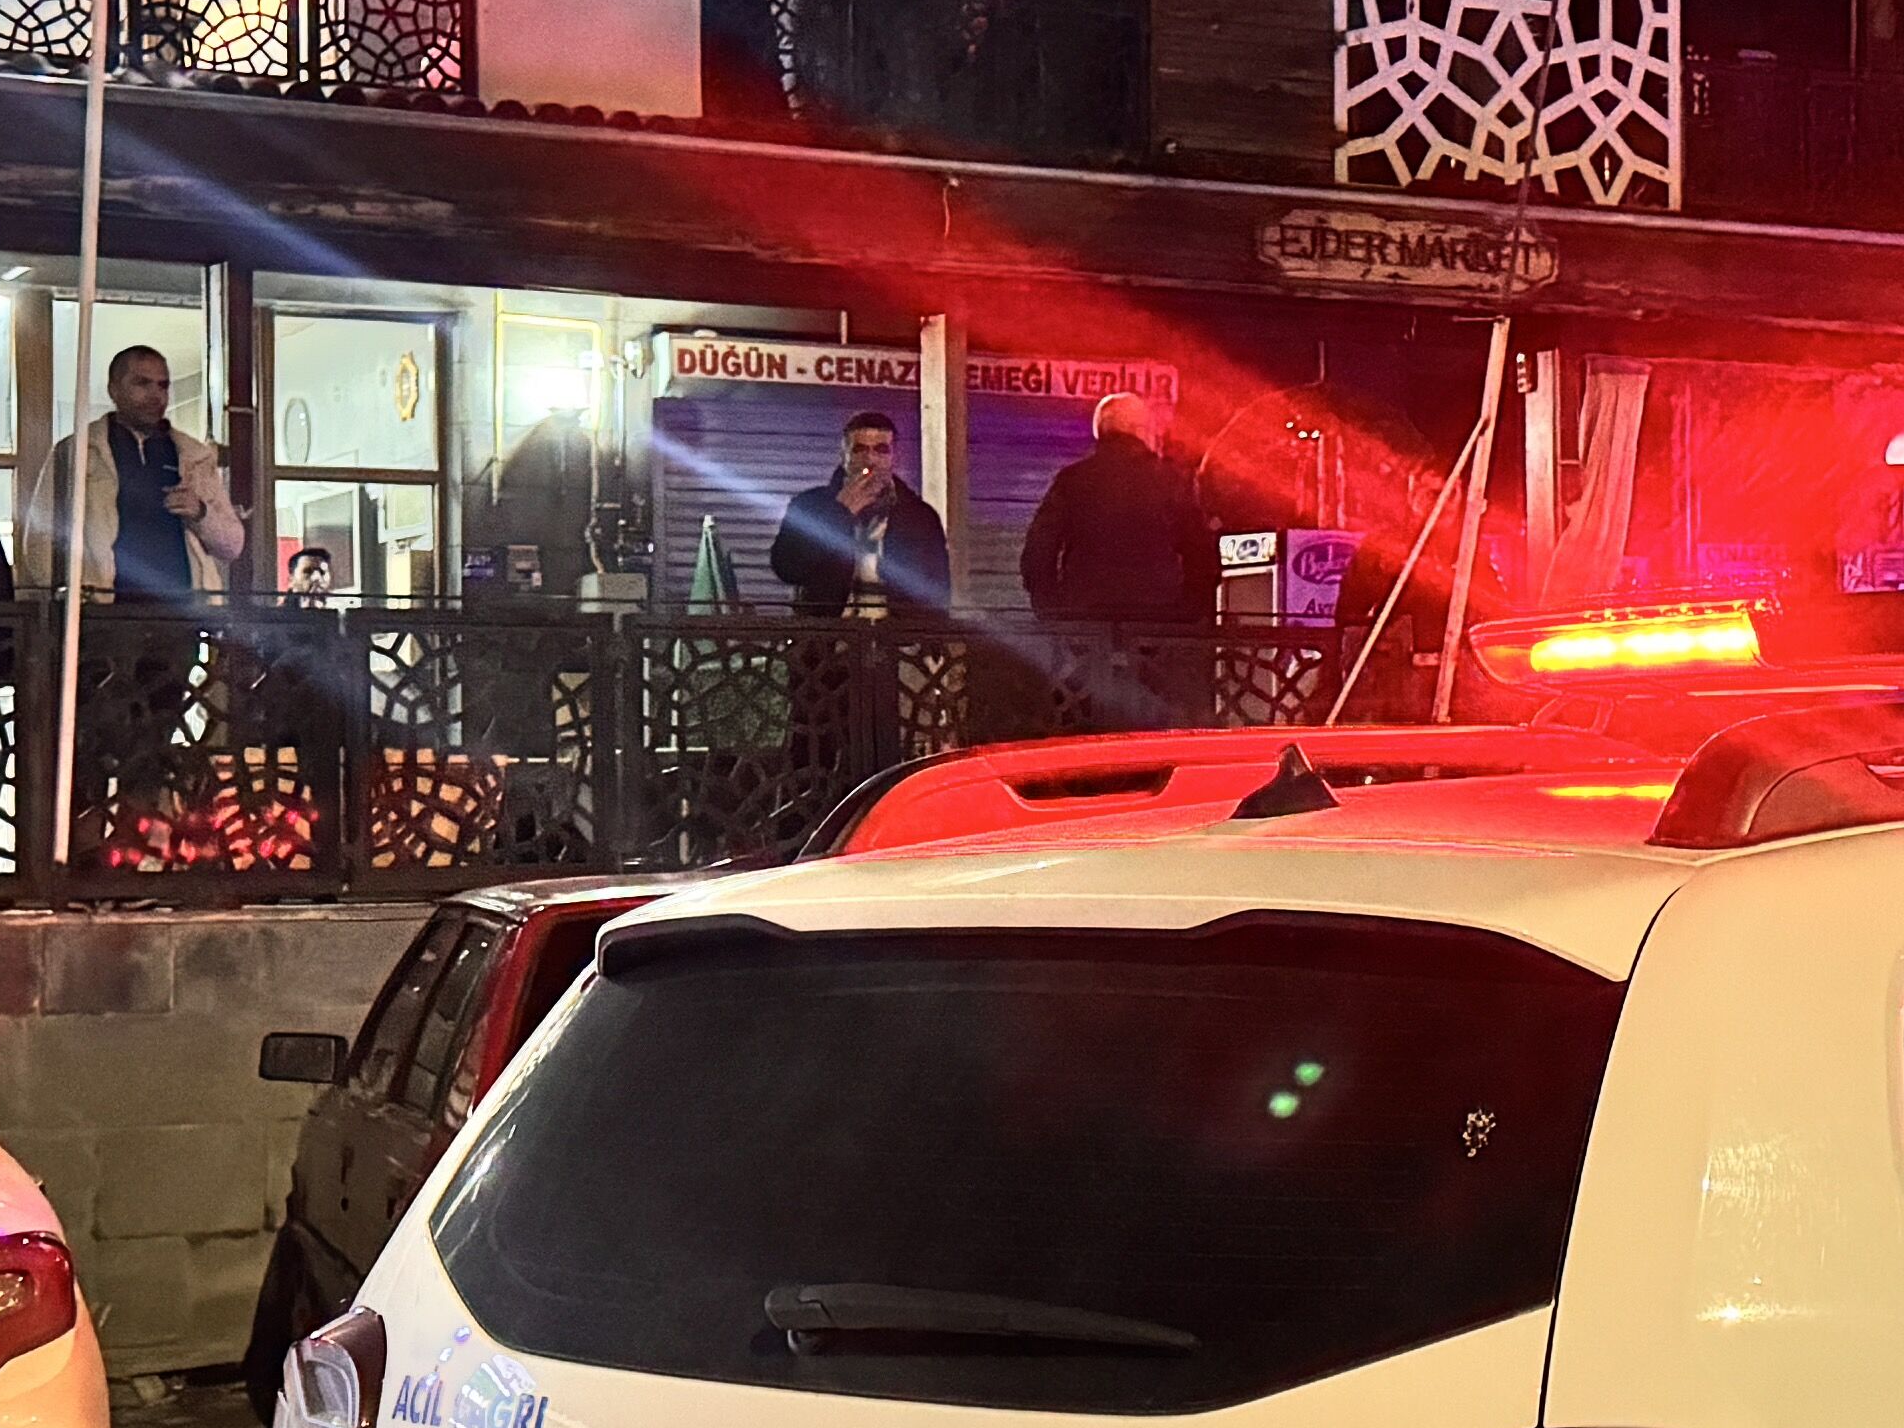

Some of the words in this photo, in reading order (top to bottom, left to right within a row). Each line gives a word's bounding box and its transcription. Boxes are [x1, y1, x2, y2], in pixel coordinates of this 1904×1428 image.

[1279, 224, 1386, 267] EJDER
[676, 345, 788, 380] DÜĞÜN
[966, 360, 1054, 394] EMEĞİ
